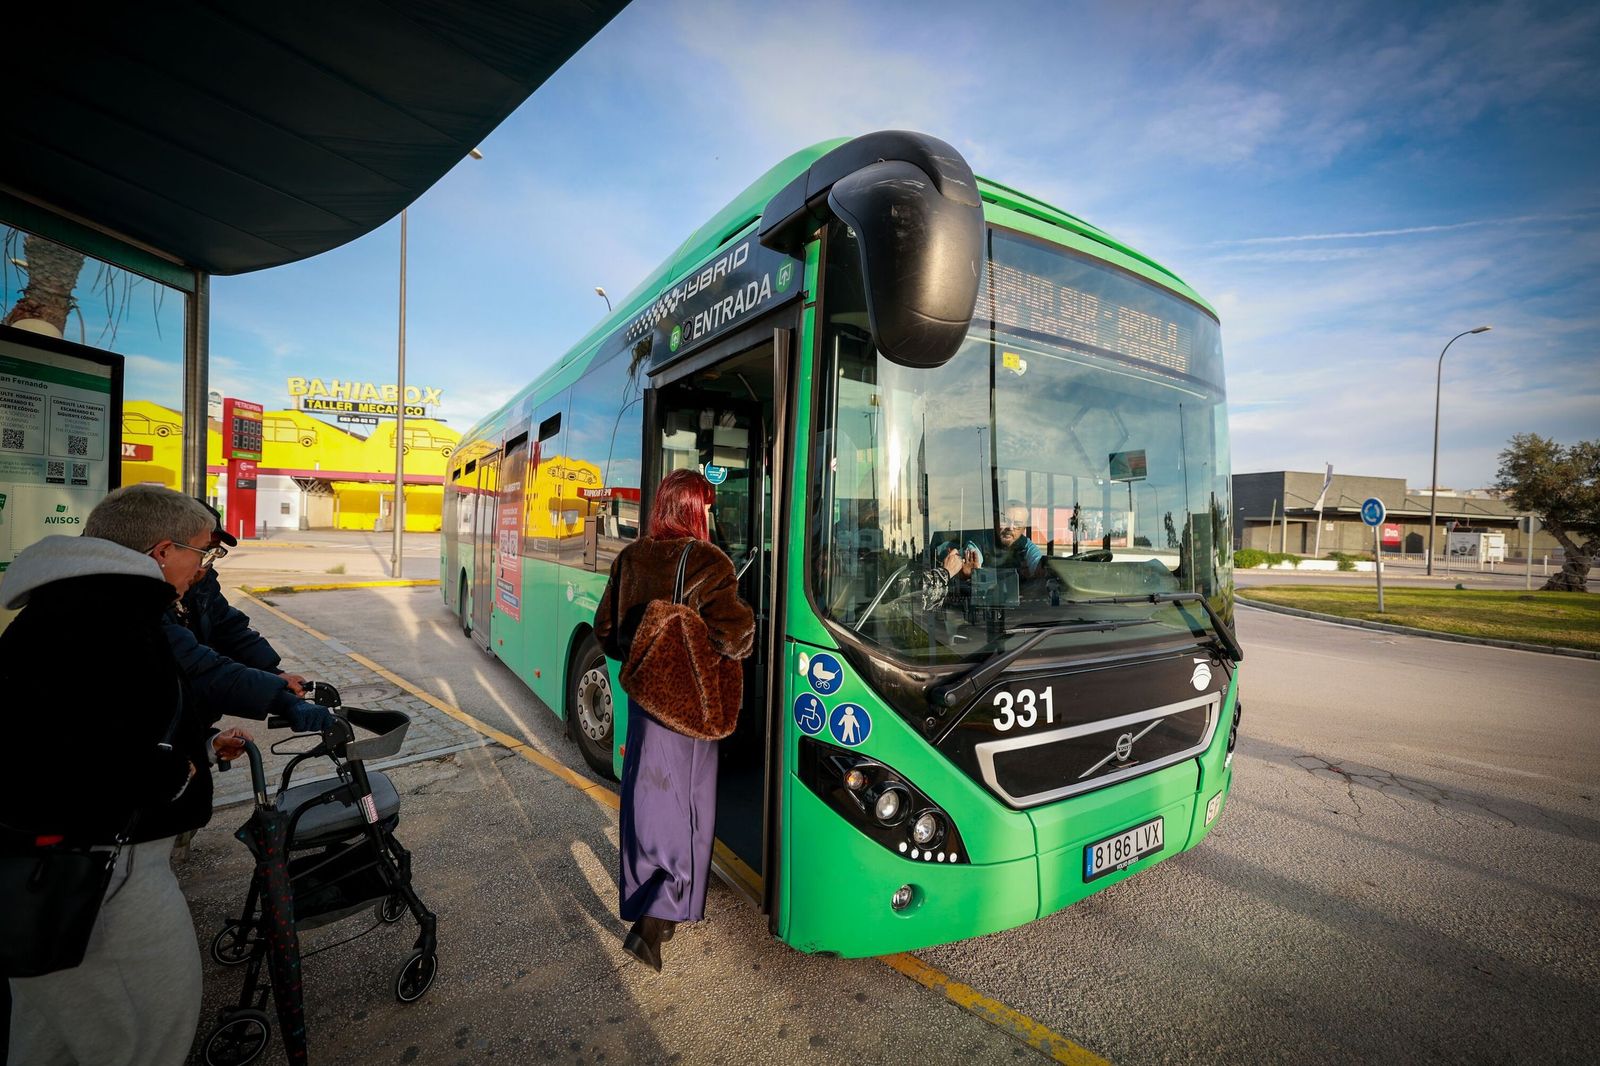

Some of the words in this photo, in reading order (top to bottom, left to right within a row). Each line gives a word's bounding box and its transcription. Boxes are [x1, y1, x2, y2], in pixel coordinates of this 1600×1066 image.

[675, 242, 750, 306] HYBRID
[692, 272, 772, 340] ENTRADA
[1060, 286, 1098, 326] SUR
[1118, 306, 1178, 351] ARDILA
[13, 377, 48, 389] Fernando
[287, 376, 443, 406] BAHIABOX
[307, 400, 353, 411] TALLER
[358, 403, 424, 415] MECANCO
[44, 516, 80, 524] AVISOS
[992, 686, 1054, 731] 331
[1095, 835, 1131, 869] 8186
[1135, 822, 1160, 852] LVX
